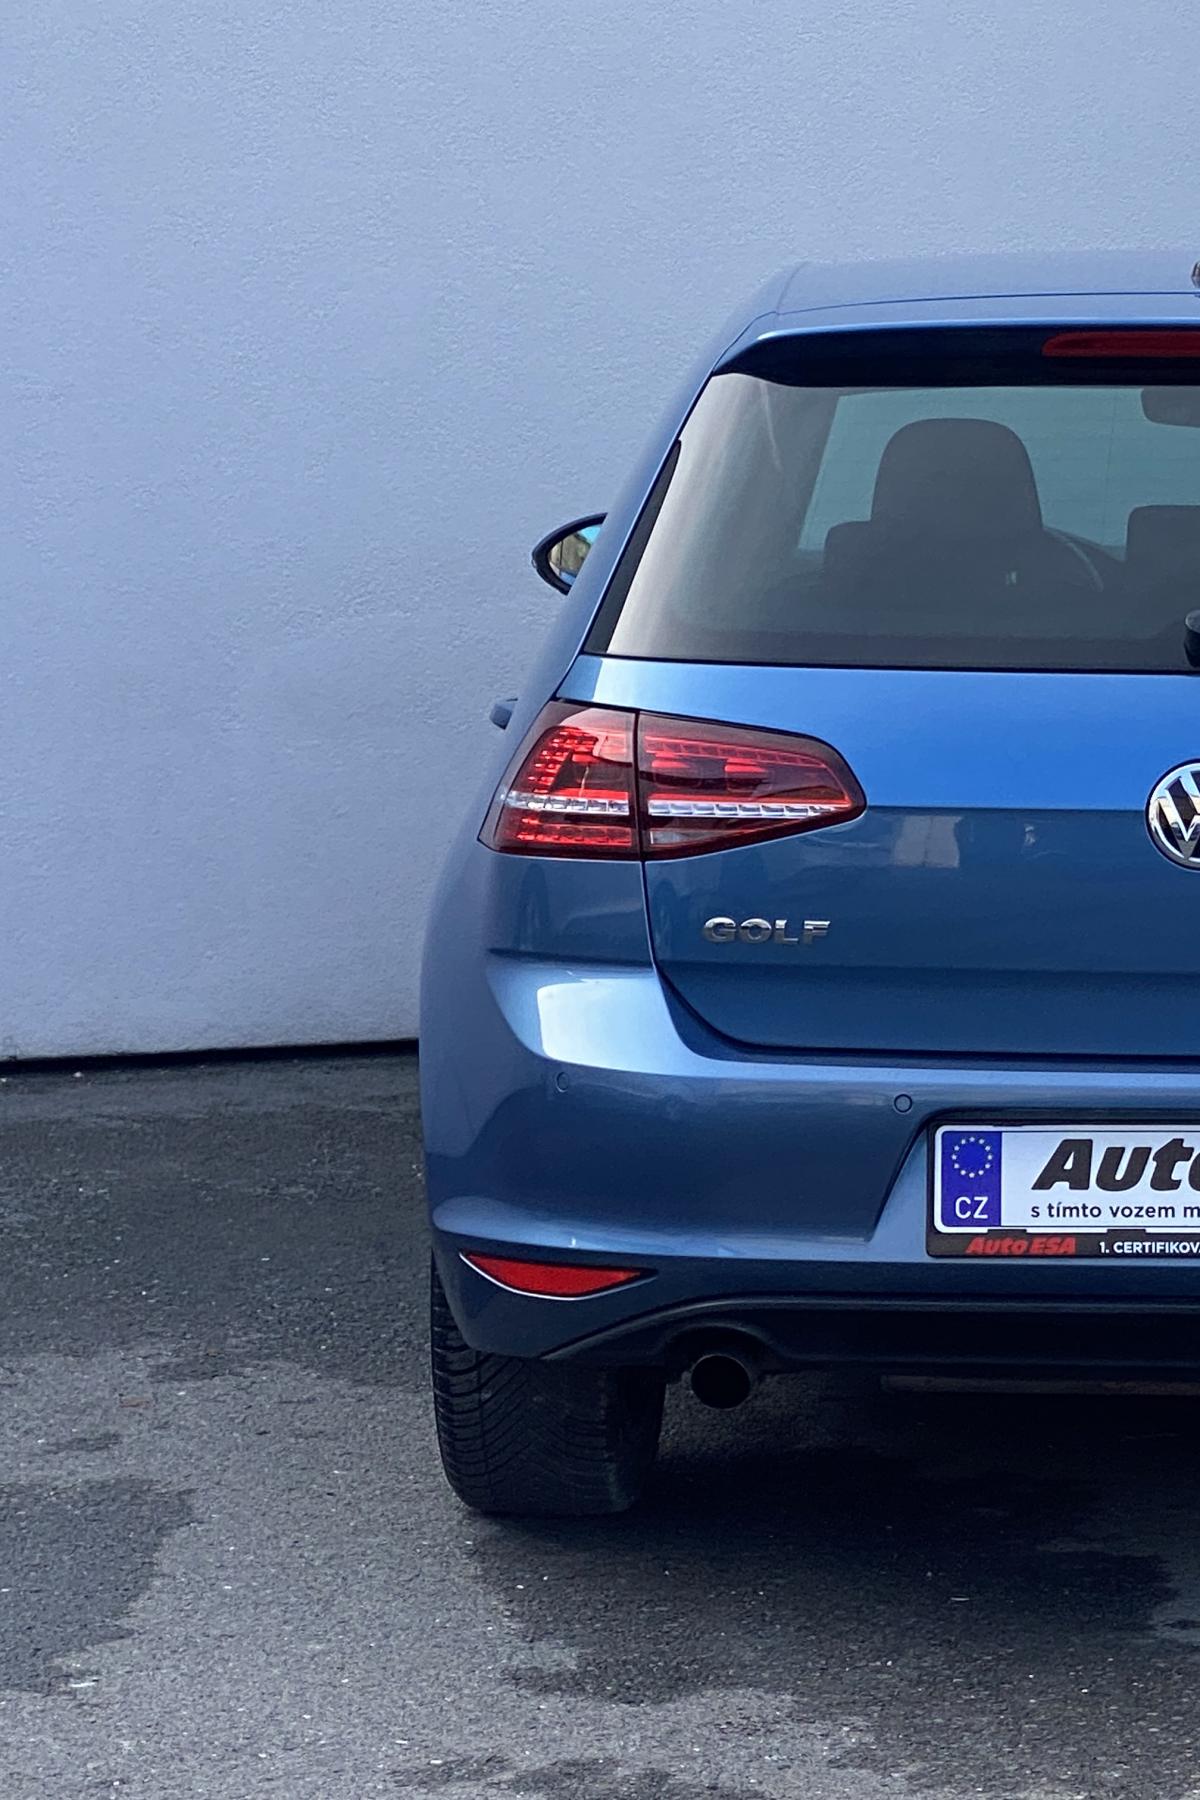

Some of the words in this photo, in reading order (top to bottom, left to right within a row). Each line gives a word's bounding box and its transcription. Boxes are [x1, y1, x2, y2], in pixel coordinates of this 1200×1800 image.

[703, 916, 831, 943] GOLF
[955, 1196, 989, 1219] CZ
[1031, 1206, 1040, 1218] s
[1048, 1202, 1101, 1218] tímto
[1109, 1206, 1175, 1218] vozem
[965, 1237, 1028, 1255] Auto
[1030, 1237, 1076, 1254] ESA
[1100, 1242, 1110, 1254] 1.
